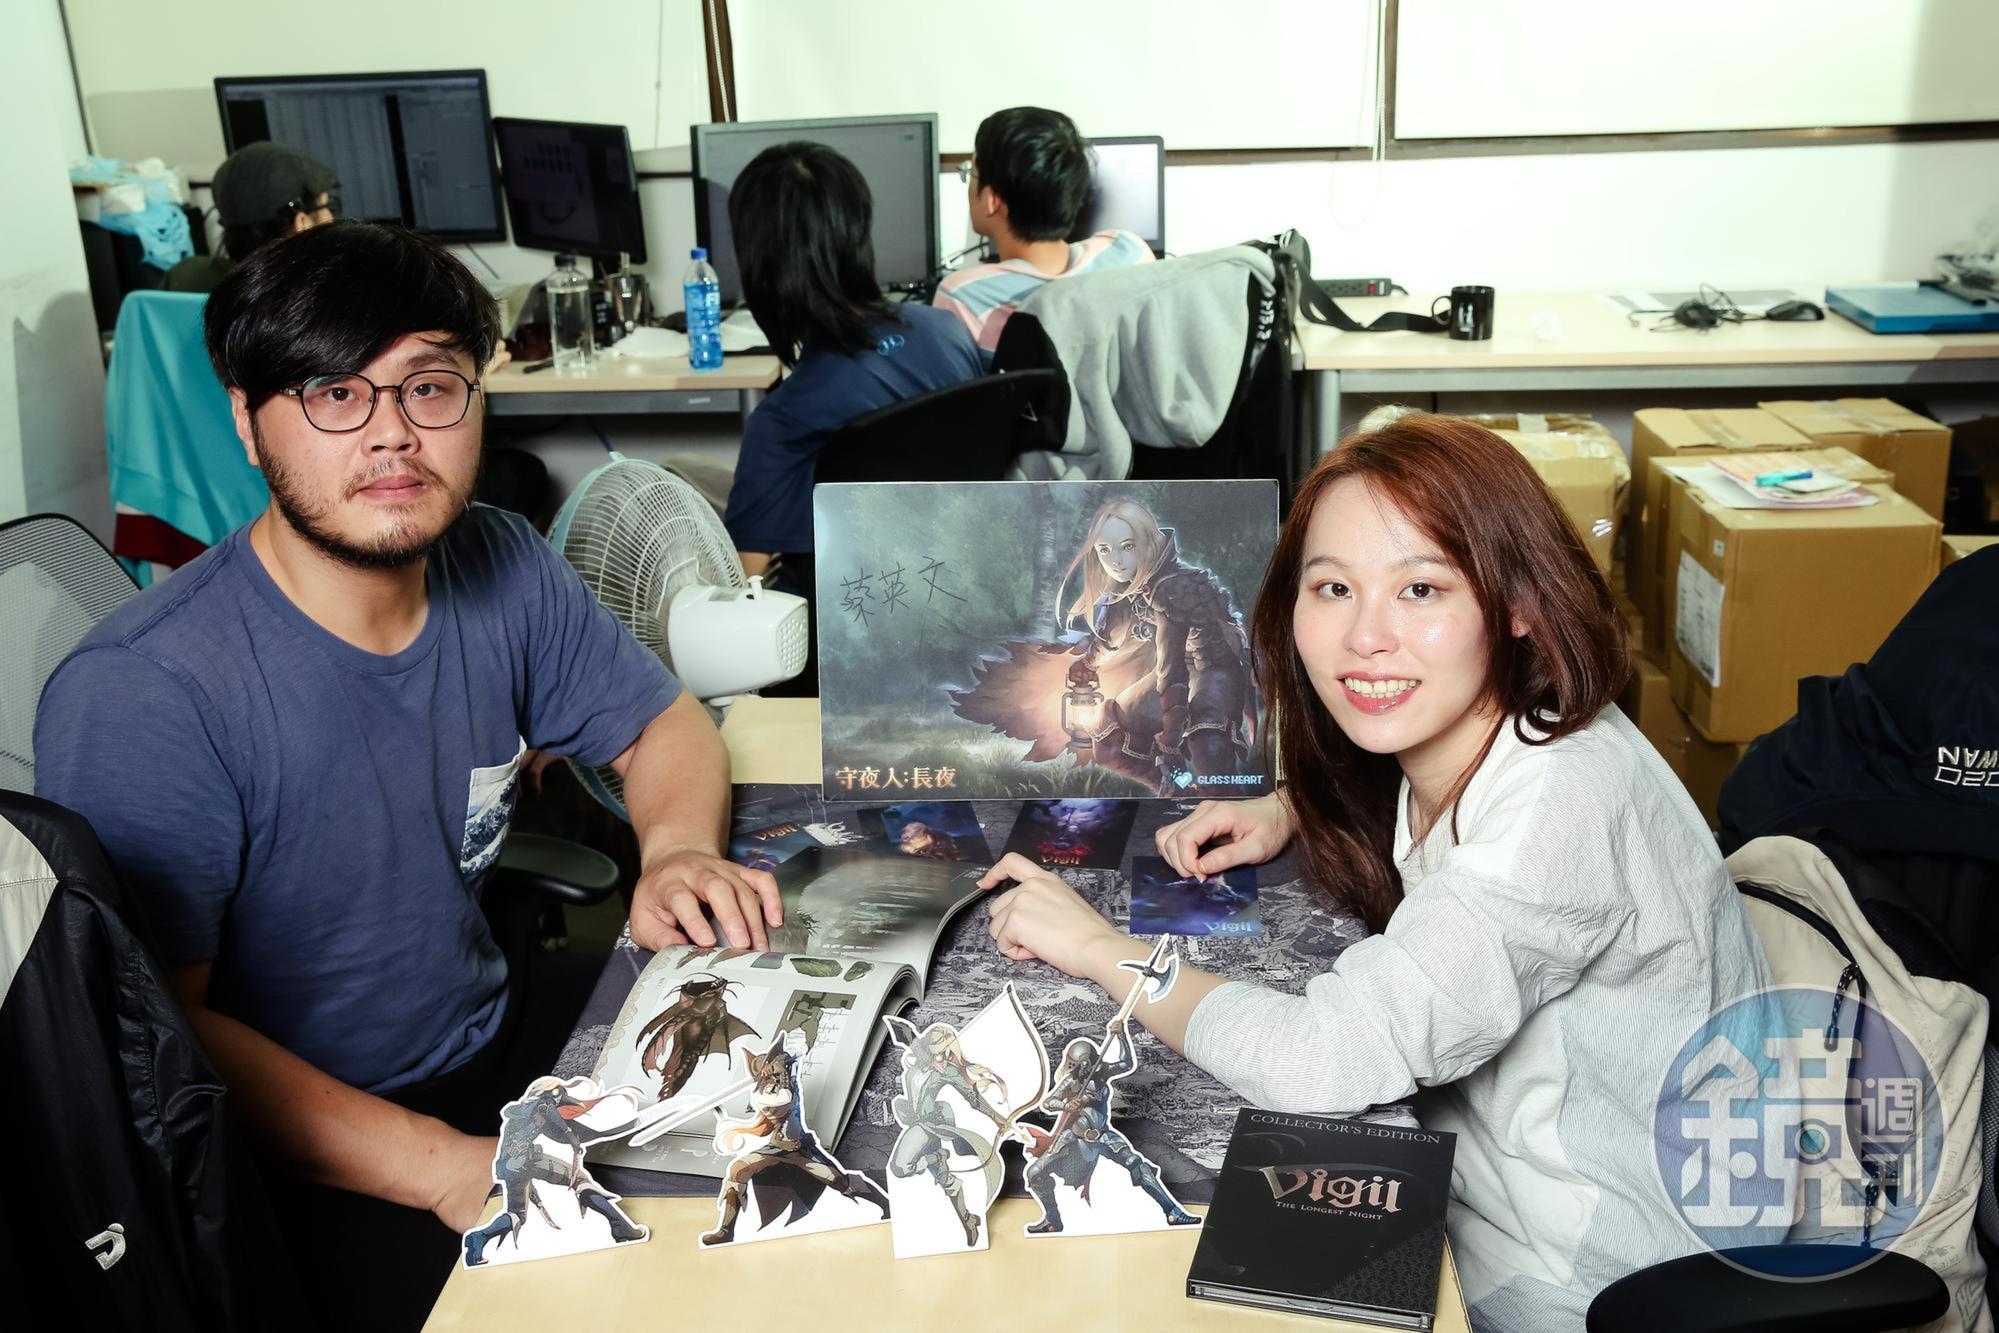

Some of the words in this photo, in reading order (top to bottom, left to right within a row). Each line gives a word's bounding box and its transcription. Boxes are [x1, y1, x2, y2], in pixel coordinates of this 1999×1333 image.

[840, 555, 968, 628] 蔡英文
[1197, 775, 1231, 785] GLASS
[1231, 775, 1264, 785] HEART
[1203, 920, 1253, 932] Vigil
[1250, 1113, 1362, 1135] COLLECTOR'S
[1366, 1127, 1441, 1145] EDITION
[1258, 1165, 1402, 1213] Vigil
